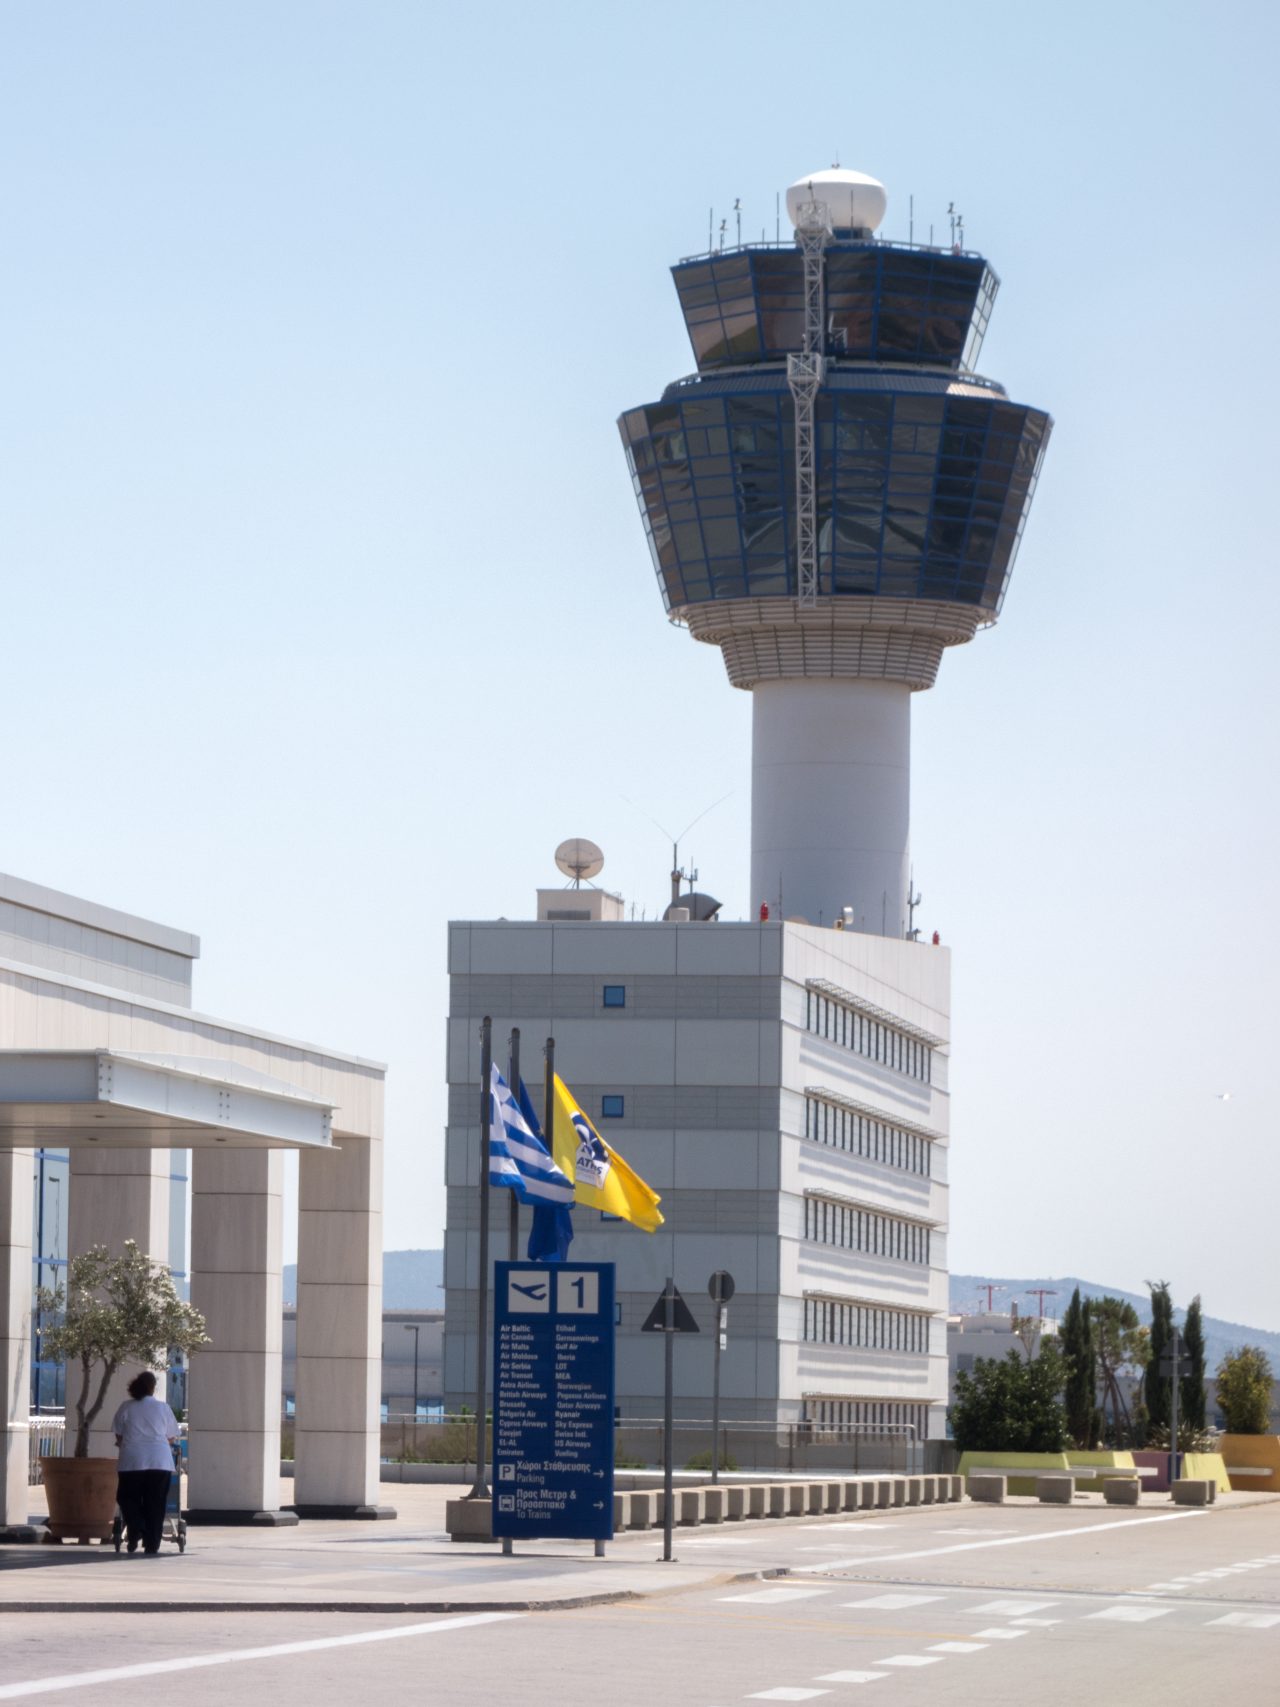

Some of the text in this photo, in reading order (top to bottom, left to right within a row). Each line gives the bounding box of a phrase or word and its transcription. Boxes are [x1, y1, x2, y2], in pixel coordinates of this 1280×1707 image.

[571, 1276, 584, 1308] 1
[555, 1421, 566, 1429] Sky
[517, 1474, 544, 1484] Parking
[517, 1489, 538, 1498] Προς
[570, 1491, 576, 1499] &
[517, 1510, 551, 1519] To Trains
